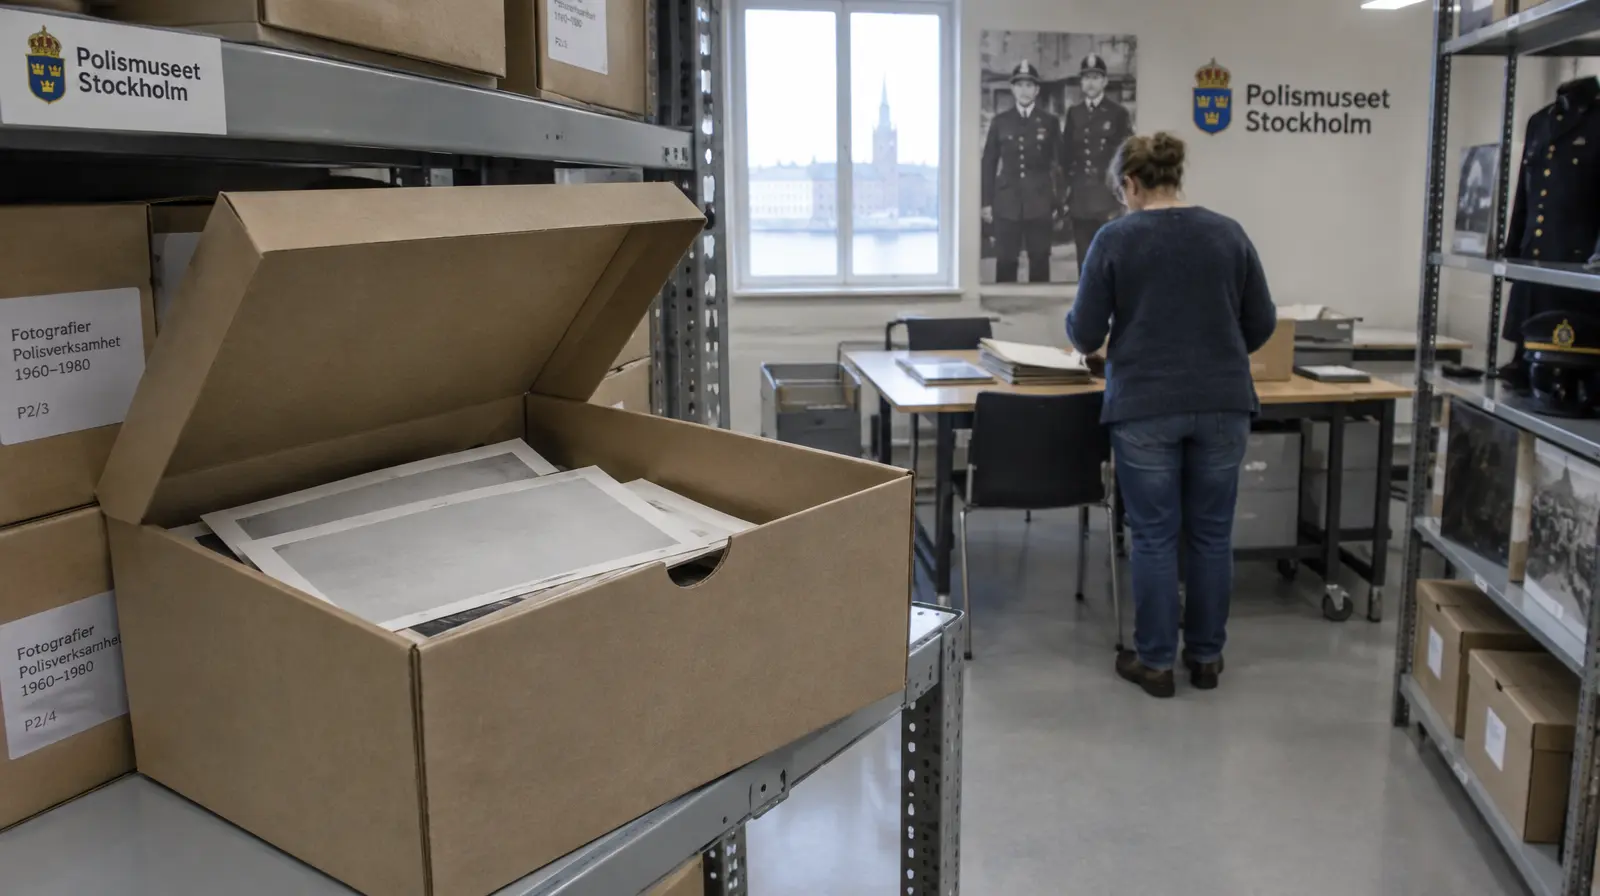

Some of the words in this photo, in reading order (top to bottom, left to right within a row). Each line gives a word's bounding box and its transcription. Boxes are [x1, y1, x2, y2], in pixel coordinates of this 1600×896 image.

[76, 46, 201, 80] Polismuseet
[79, 72, 188, 101] Stockholm
[1246, 84, 1391, 109] Polismuseet
[1246, 110, 1372, 134] Stockholm
[11, 321, 92, 341] Fotografier
[13, 336, 121, 361] Polisverksamhet
[17, 402, 50, 419] P2/3
[17, 625, 95, 661] Fotografier
[25, 708, 57, 732] P2/4
